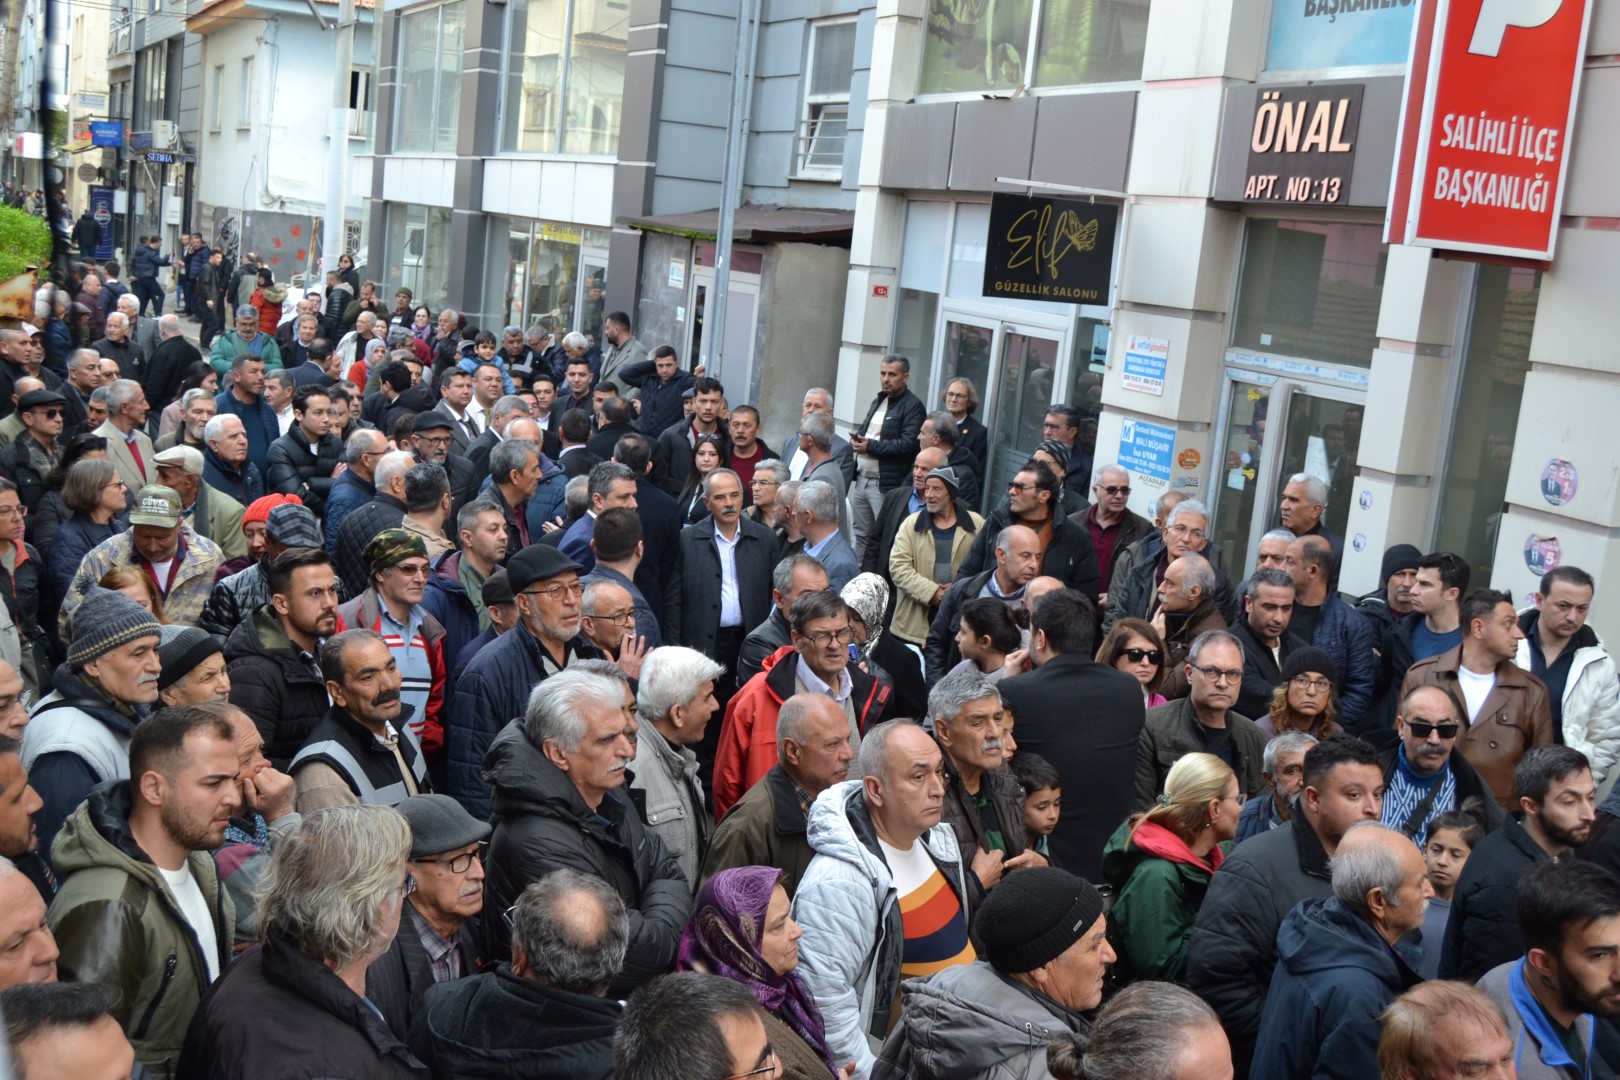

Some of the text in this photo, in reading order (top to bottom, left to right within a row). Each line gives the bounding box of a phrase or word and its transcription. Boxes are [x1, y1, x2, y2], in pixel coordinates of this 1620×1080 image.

[1251, 91, 1352, 153] ÖNAL
[1440, 111, 1559, 165] SALİHLİ İLÇE
[1244, 175, 1279, 200] APT.
[1434, 166, 1550, 213] BAŞKANLIĞI
[1007, 204, 1072, 279] Elif
[995, 280, 1098, 299] GÜZELLİK SALONU
[1142, 450, 1157, 462] UYAR
[142, 496, 169, 507] GÜVEN
